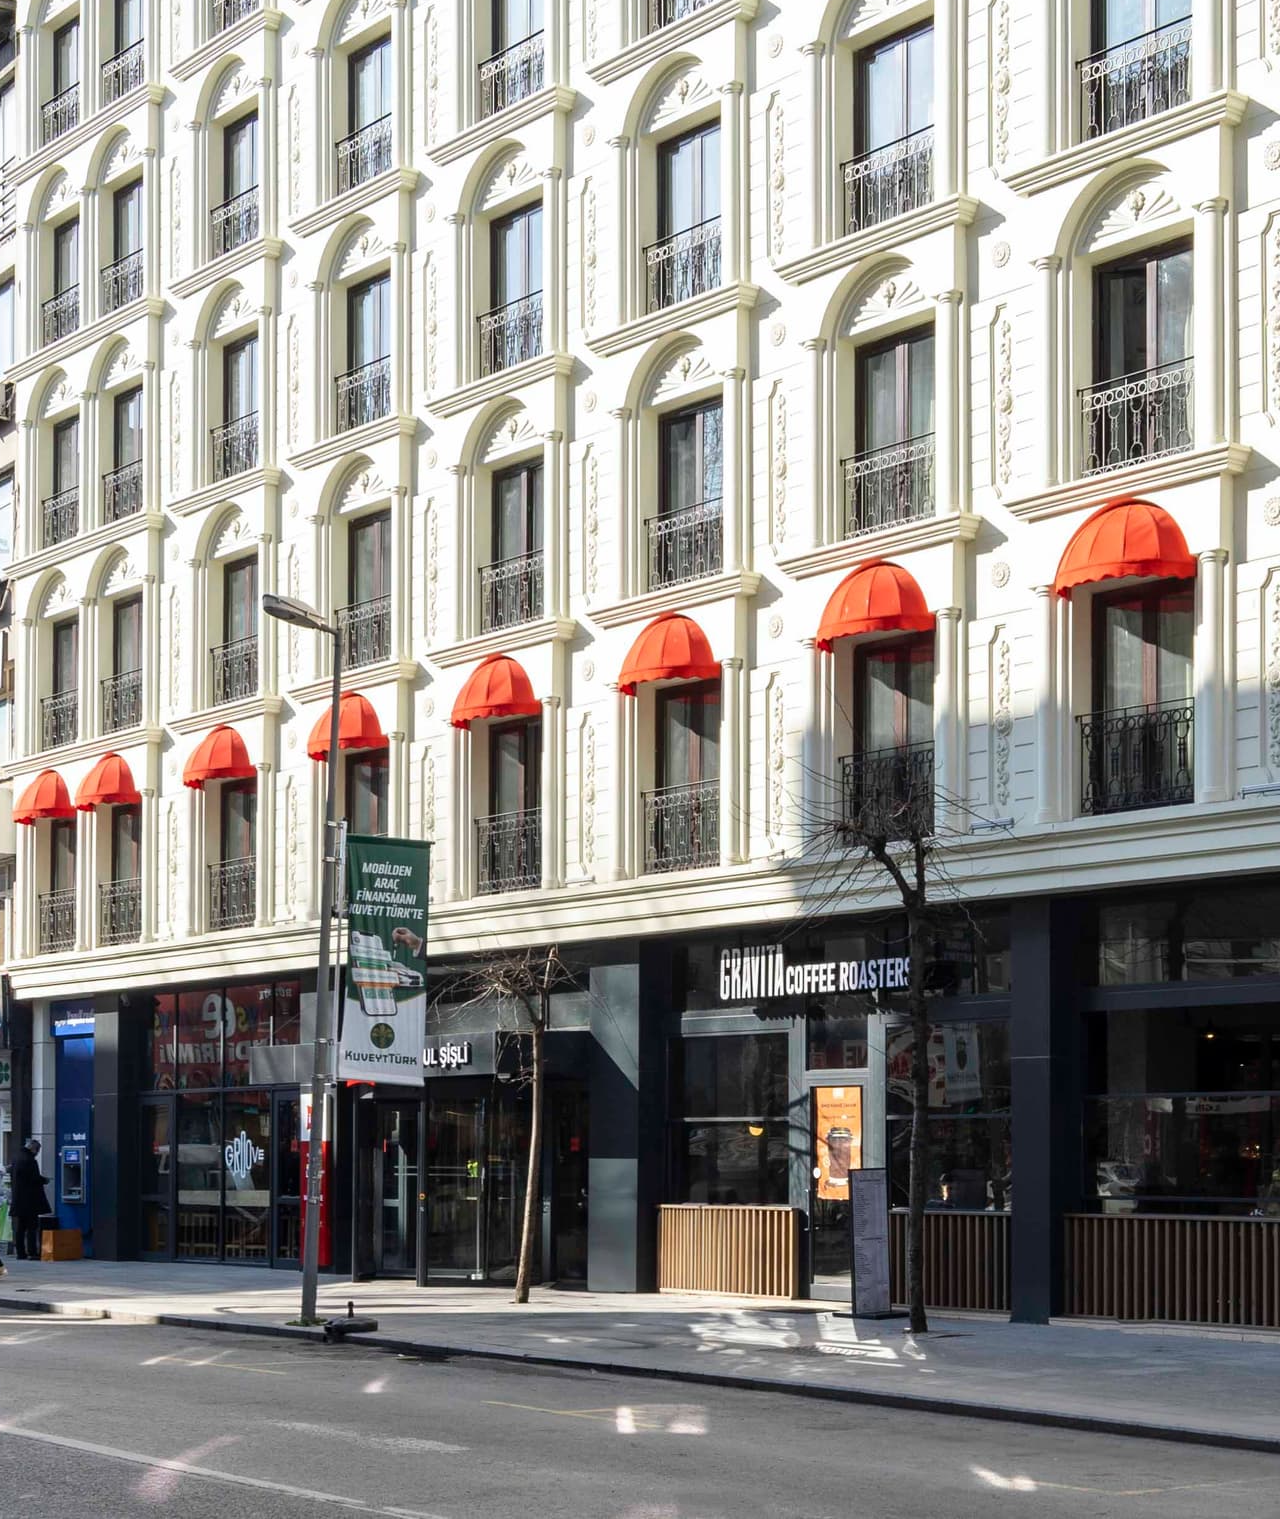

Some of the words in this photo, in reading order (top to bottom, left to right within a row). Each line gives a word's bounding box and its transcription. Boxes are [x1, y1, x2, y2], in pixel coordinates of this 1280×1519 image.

[361, 860, 412, 877] MOBİLDEN
[374, 877, 400, 892] ARAÇ
[355, 887, 417, 906] FİNANSMANI
[349, 902, 383, 918] KUVEYT
[384, 904, 424, 920] TÜRK'TE
[720, 944, 785, 1001] GRAVITA
[786, 962, 836, 996] COFFEE
[839, 956, 910, 991] ROASTERS
[439, 1041, 468, 1069] ŞİŞLİ
